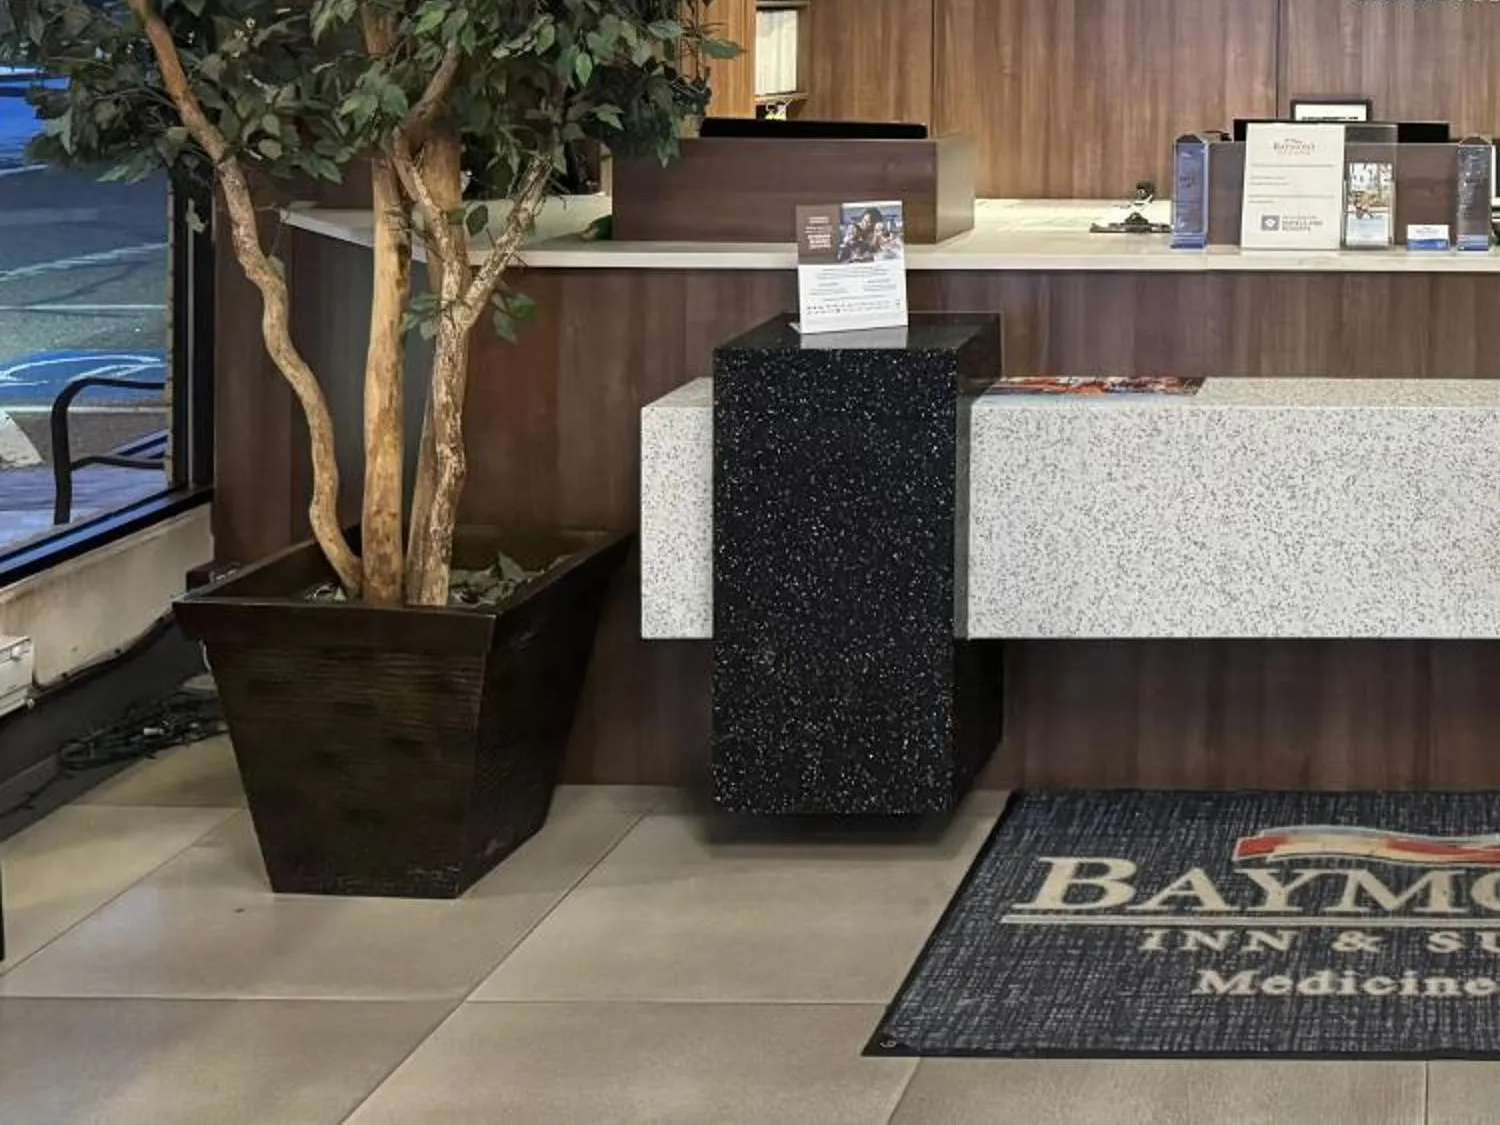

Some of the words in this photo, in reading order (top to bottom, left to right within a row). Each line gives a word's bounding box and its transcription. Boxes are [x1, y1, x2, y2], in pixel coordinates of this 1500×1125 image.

[1137, 929, 1300, 952] INN
[1330, 930, 1384, 953] &
[1191, 969, 1498, 997] Medicine
